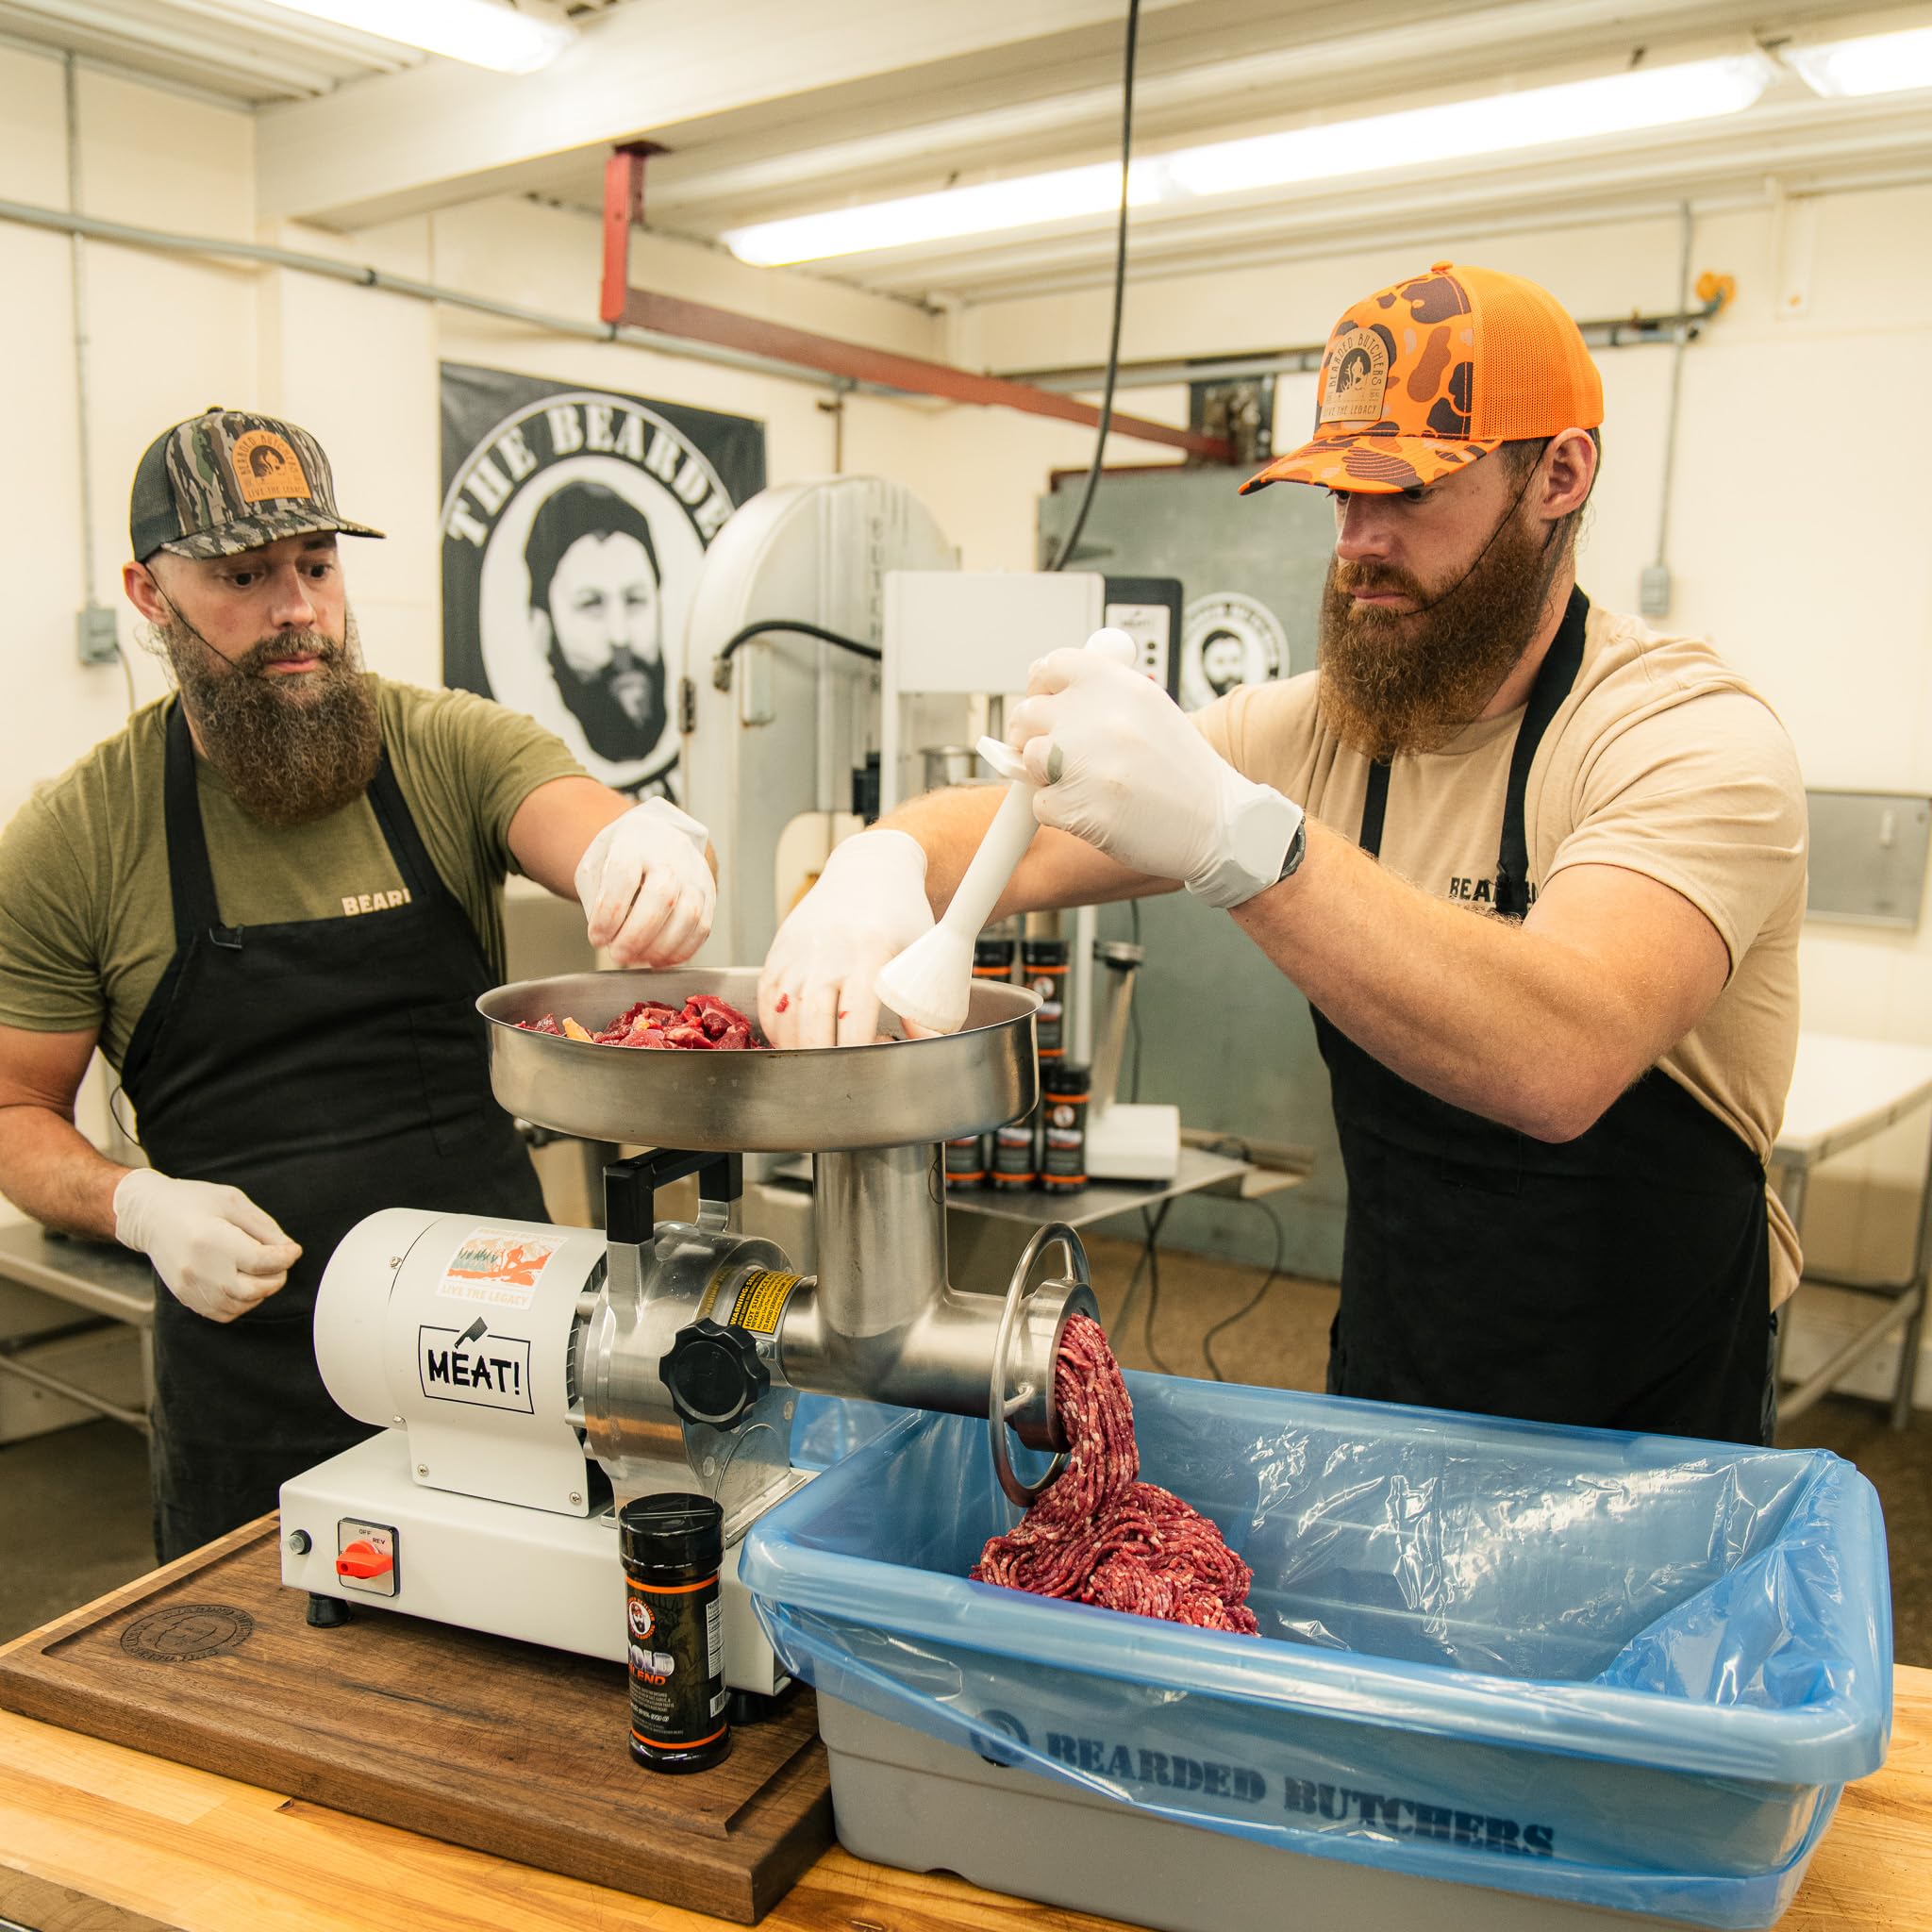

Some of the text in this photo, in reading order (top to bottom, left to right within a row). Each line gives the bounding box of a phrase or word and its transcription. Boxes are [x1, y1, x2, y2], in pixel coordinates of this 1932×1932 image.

[1357, 332, 1384, 386] BUTCHERS
[1350, 405, 1378, 415] LEGACY
[447, 403, 738, 548] THE BEARDE
[745, 1310, 755, 1326] HOT
[427, 1348, 520, 1395] MEAT!
[1044, 1730, 1556, 1858] BEARDED BUTCHERS
